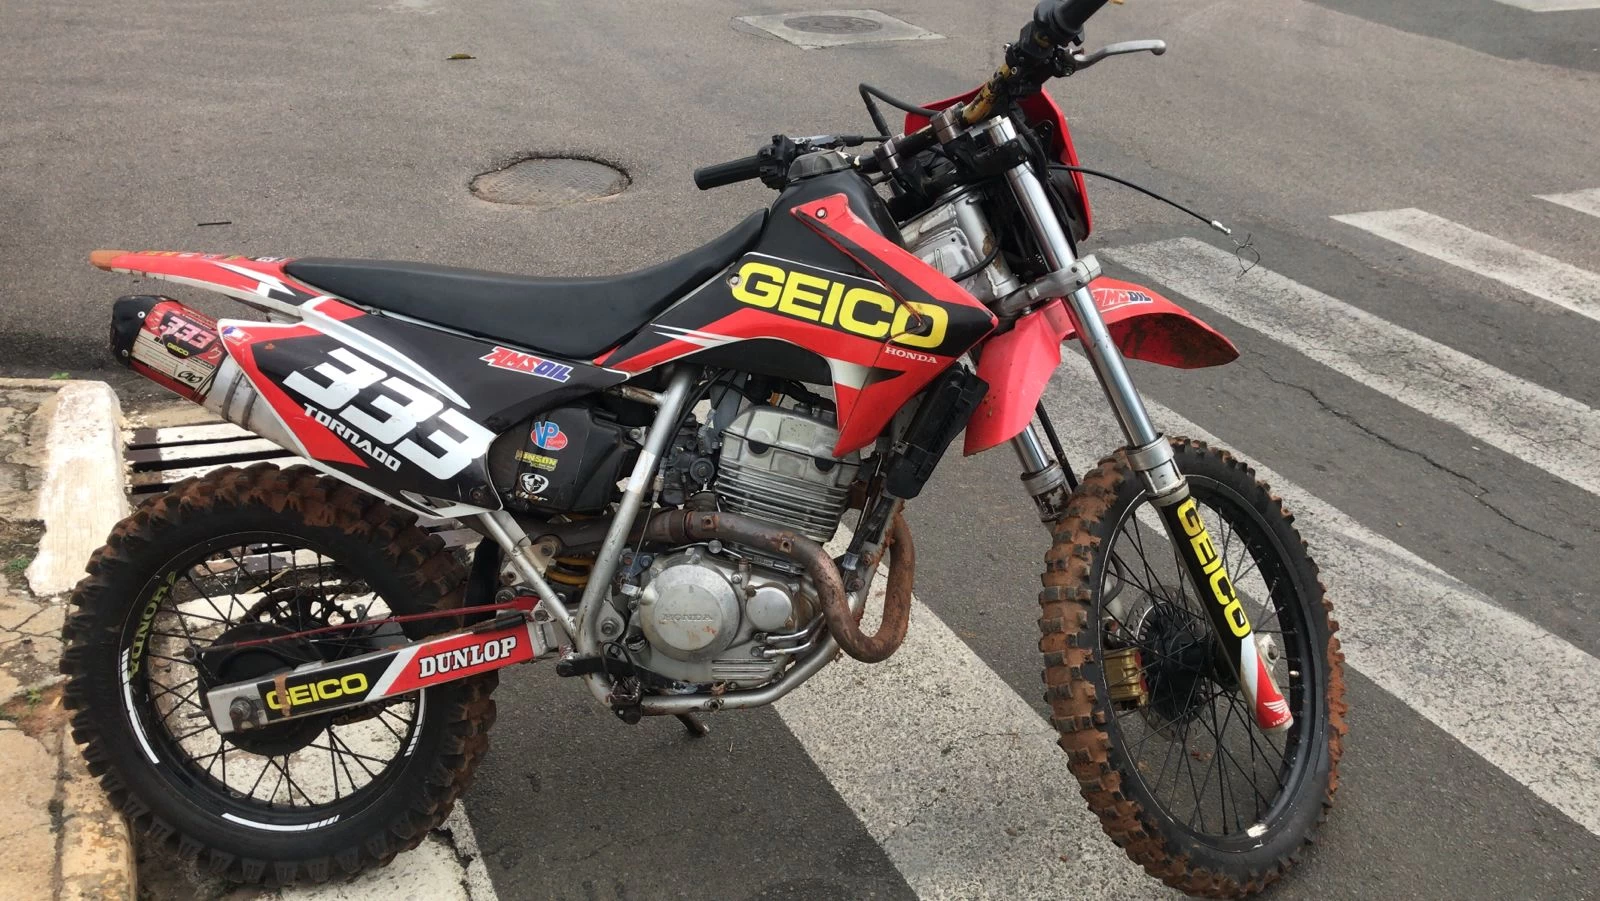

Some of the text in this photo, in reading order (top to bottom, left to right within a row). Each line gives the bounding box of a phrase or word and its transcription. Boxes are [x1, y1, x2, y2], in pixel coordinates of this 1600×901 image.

[731, 262, 948, 348] GEICO
[161, 316, 217, 348] 333
[484, 346, 573, 382] AMSOIL
[885, 346, 938, 364] HONDA
[282, 347, 497, 480] 333
[303, 403, 402, 472] TORNADO
[534, 421, 560, 449] VP
[1177, 498, 1251, 637] GEICO
[128, 582, 168, 680] HONDA
[663, 613, 713, 623] HONDA
[419, 636, 518, 678] DUNLOP
[266, 672, 368, 710] GEICO
